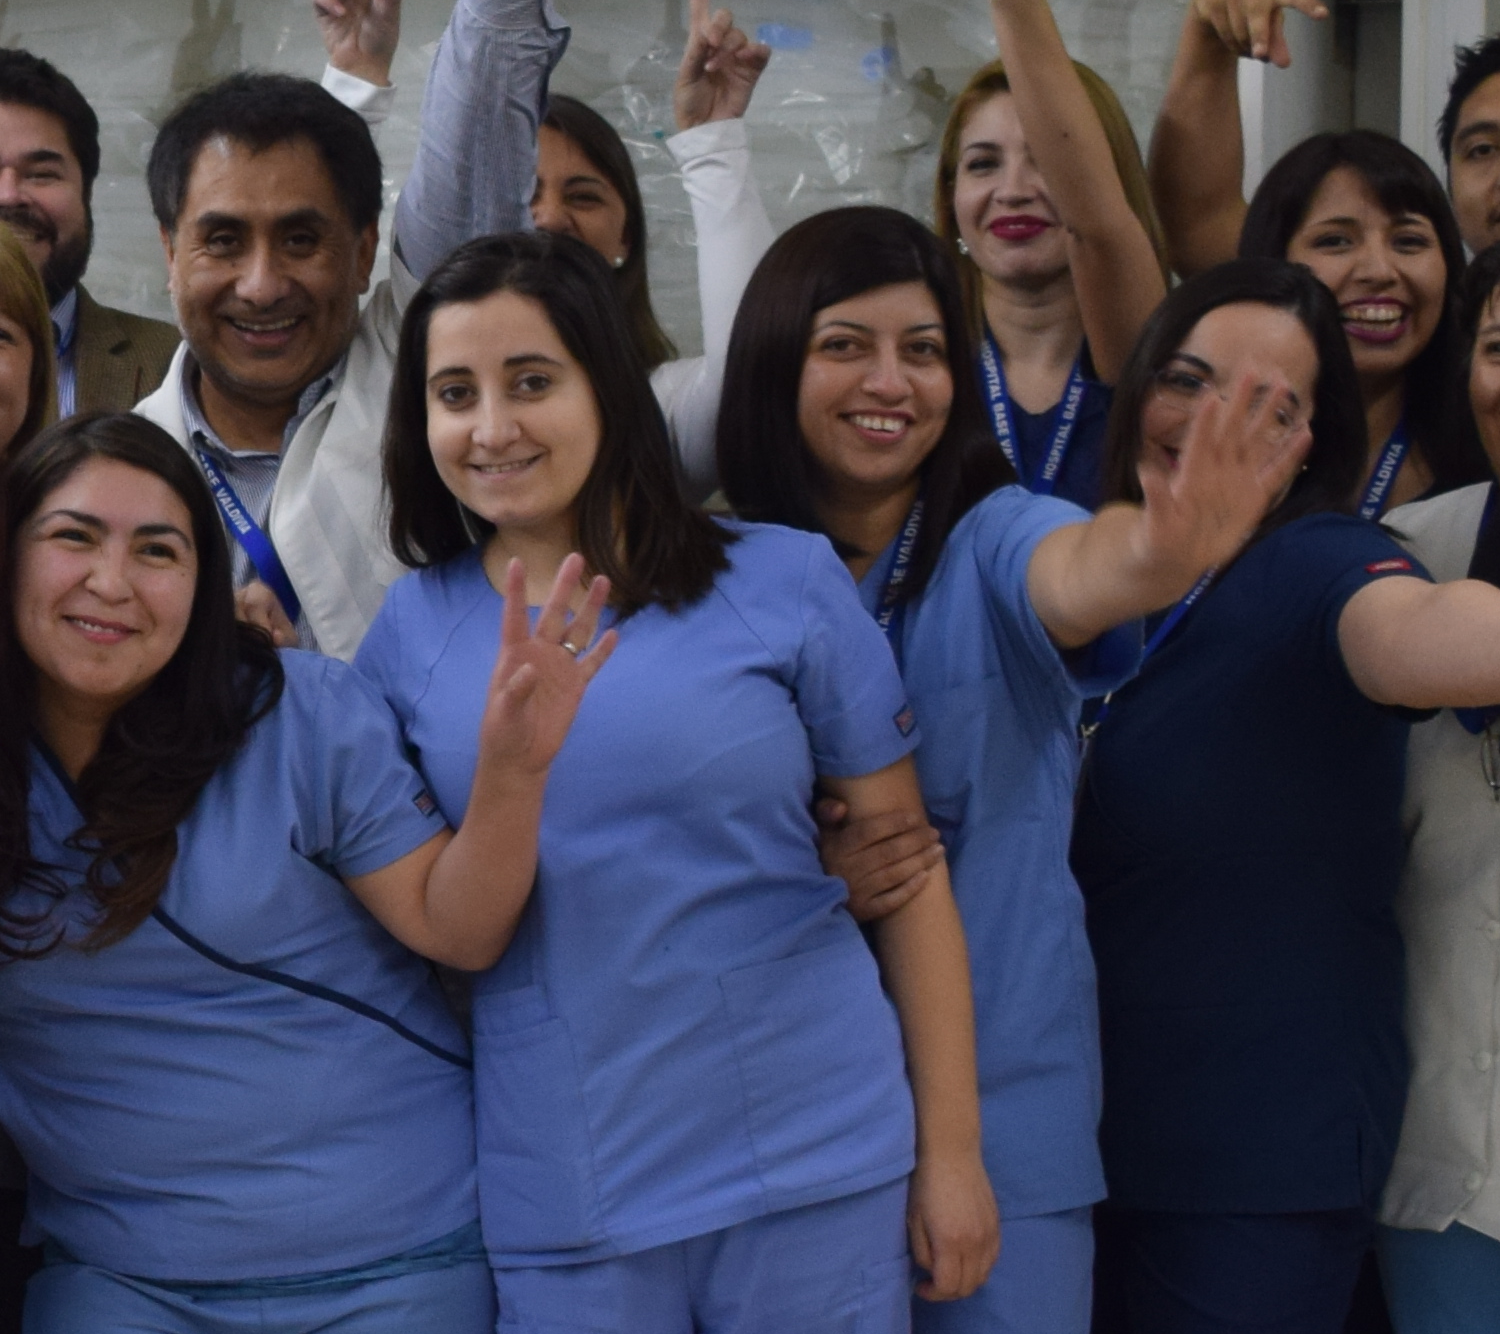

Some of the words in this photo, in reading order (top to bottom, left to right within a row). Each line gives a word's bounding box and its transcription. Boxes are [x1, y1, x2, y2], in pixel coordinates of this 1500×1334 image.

[992, 402, 1010, 436] BASE
[1041, 423, 1072, 481] HOSPITAL
[1062, 385, 1083, 419] BASE
[1366, 443, 1404, 504] VALDIVIA
[215, 487, 252, 535] VALDIVIA
[896, 499, 924, 564] VALDIVIA
